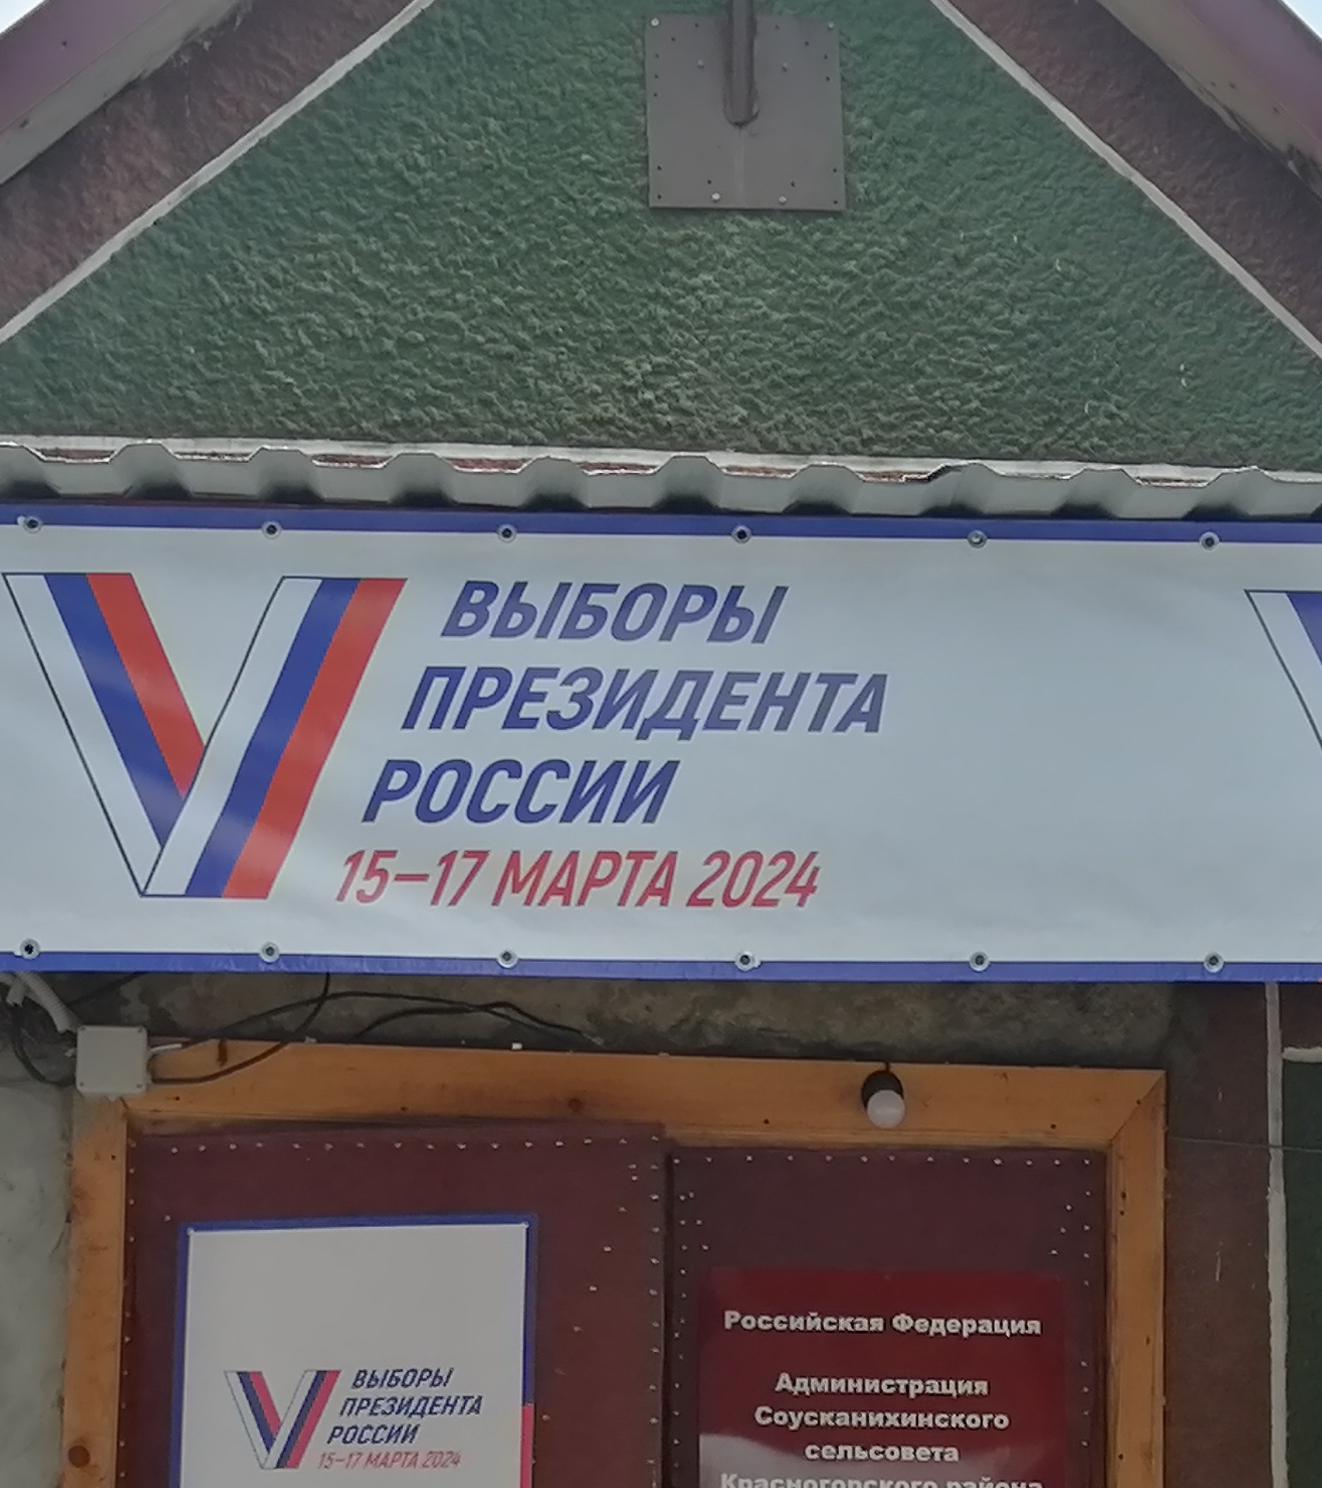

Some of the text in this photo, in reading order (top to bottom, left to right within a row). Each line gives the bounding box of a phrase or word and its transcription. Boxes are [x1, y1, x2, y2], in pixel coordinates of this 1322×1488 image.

[441, 580, 788, 643] ВЫБОРЫ
[401, 666, 887, 740] ПРЕЗИДЕНТА
[362, 759, 680, 823] РОССИИ
[492, 850, 675, 906] МАРТА
[686, 850, 819, 906] 2024
[724, 1311, 1041, 1337] Российская Федерация
[352, 1368, 453, 1389] ВЫБОРЫ
[775, 1372, 988, 1398] Администрация
[340, 1396, 482, 1418] ПРЕЗИДЕНТА
[754, 1406, 1010, 1430] Соусканихинского
[327, 1424, 420, 1444] РОССИИ
[363, 1452, 419, 1469] МАРТА
[422, 1451, 461, 1468] 2024
[804, 1443, 960, 1462] сельсовета
